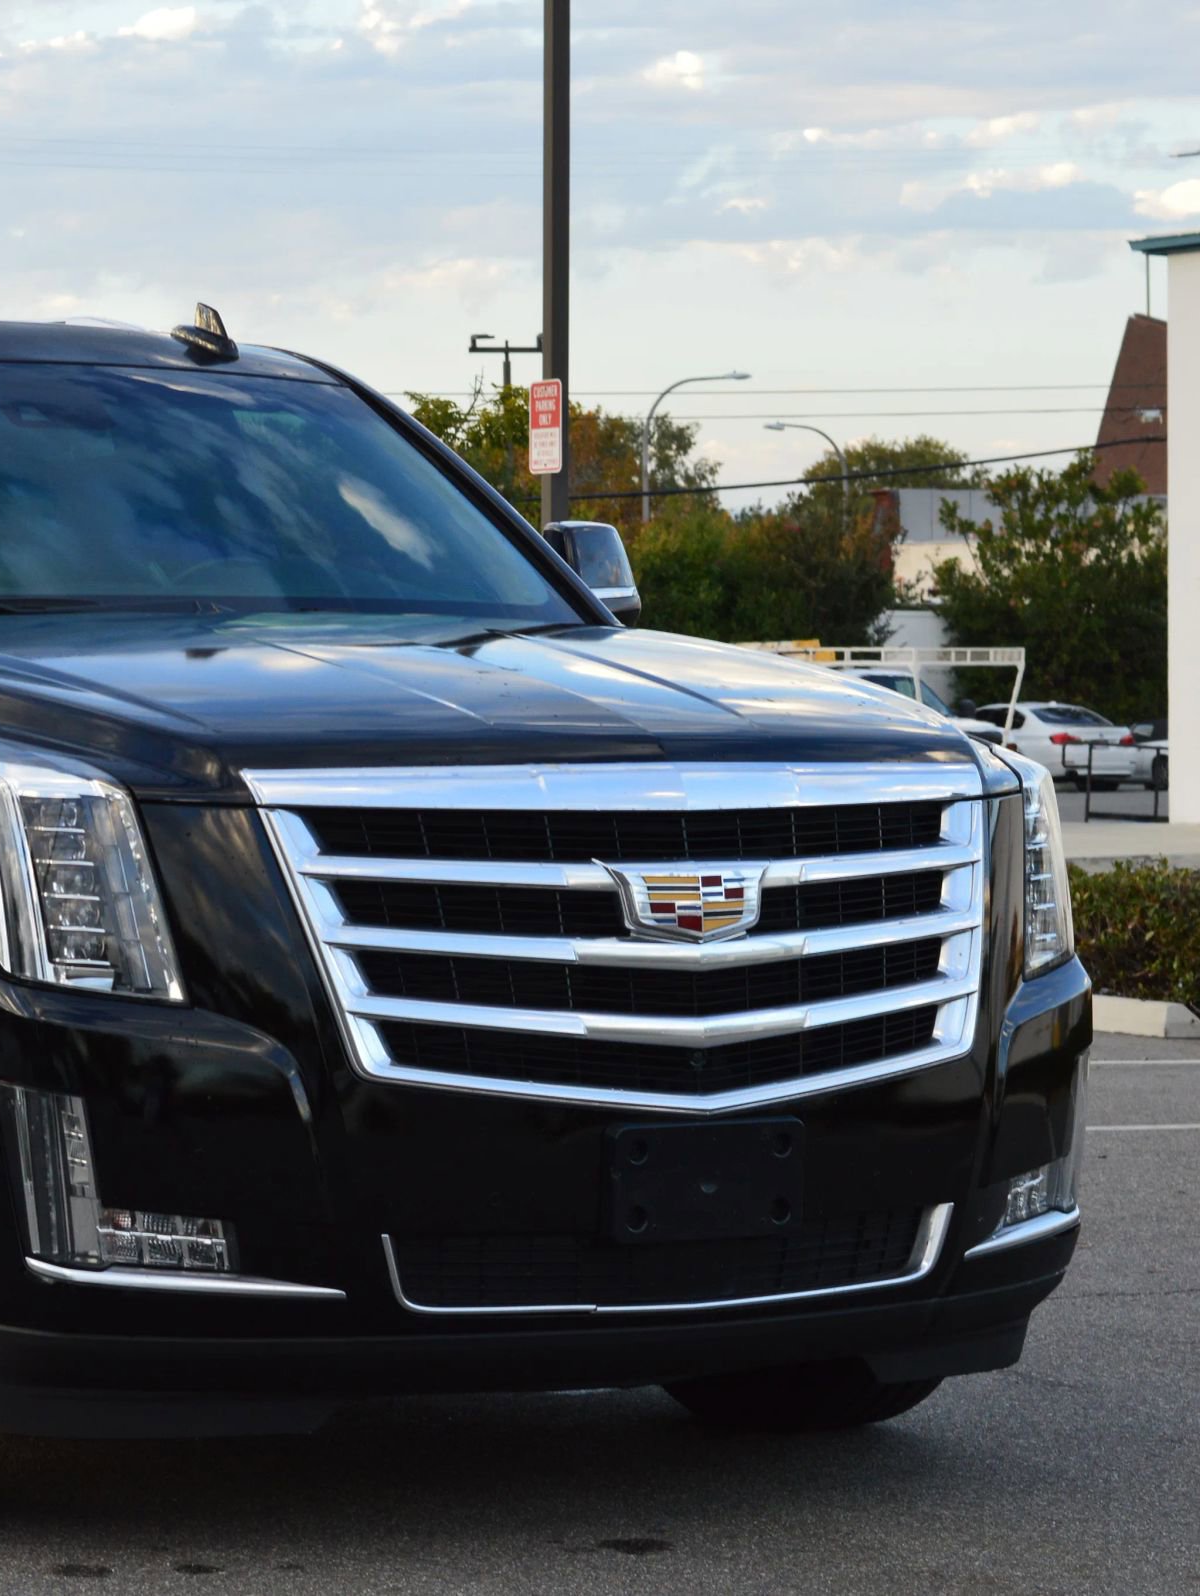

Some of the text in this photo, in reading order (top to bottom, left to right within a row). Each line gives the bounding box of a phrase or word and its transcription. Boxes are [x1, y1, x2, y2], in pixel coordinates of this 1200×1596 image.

[533, 384, 558, 399] CUSTOMER
[535, 398, 556, 412] PARKING
[538, 413, 552, 426] ONLY
